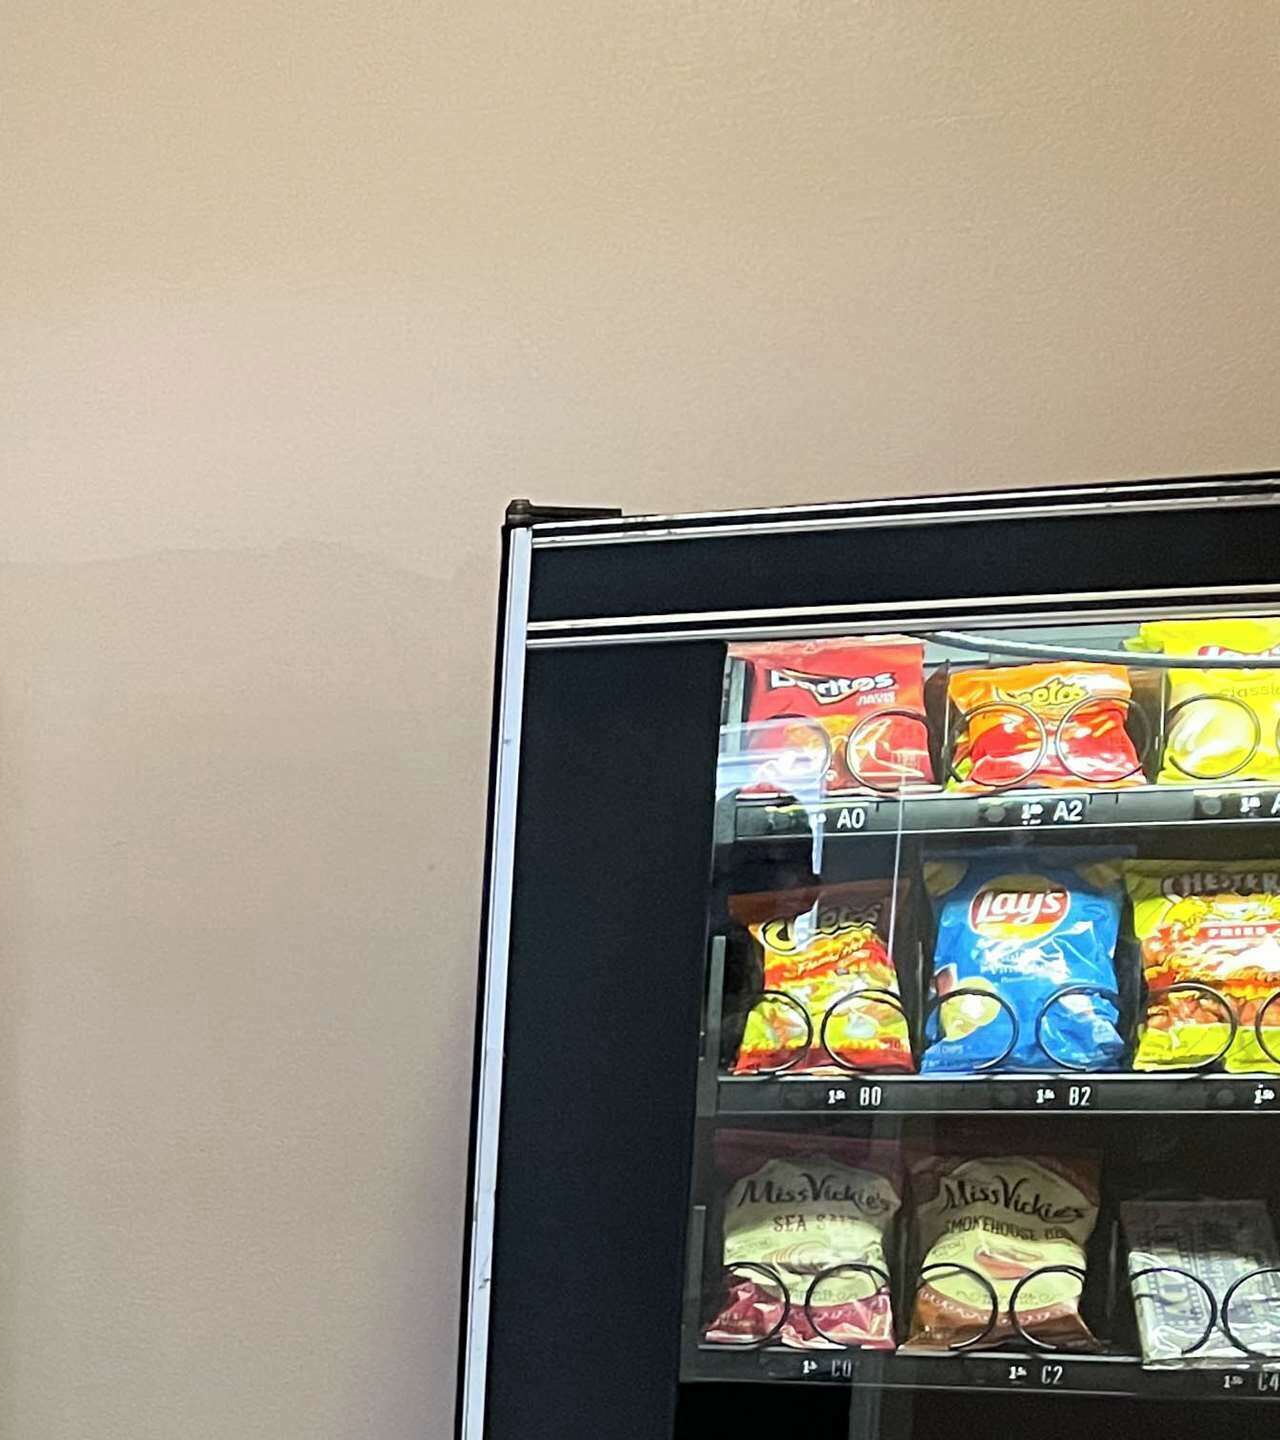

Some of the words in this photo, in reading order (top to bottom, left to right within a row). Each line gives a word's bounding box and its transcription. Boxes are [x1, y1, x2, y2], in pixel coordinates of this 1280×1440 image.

[770, 669, 896, 697] Doritos
[837, 808, 865, 829] A0
[1053, 800, 1083, 822] A2
[976, 888, 1066, 924] Lay's
[859, 1086, 882, 1106] B0
[1069, 1086, 1091, 1107] B2
[737, 1179, 807, 1208] Miss
[801, 1172, 890, 1216] Vickie's
[942, 1179, 998, 1214] Miss
[994, 1174, 1090, 1225] Vickie's
[773, 1213, 807, 1233] SEA
[945, 1214, 1040, 1242] SMOKEHOUSE
[1041, 1366, 1064, 1385] C2
[1258, 1372, 1280, 1391] C4
